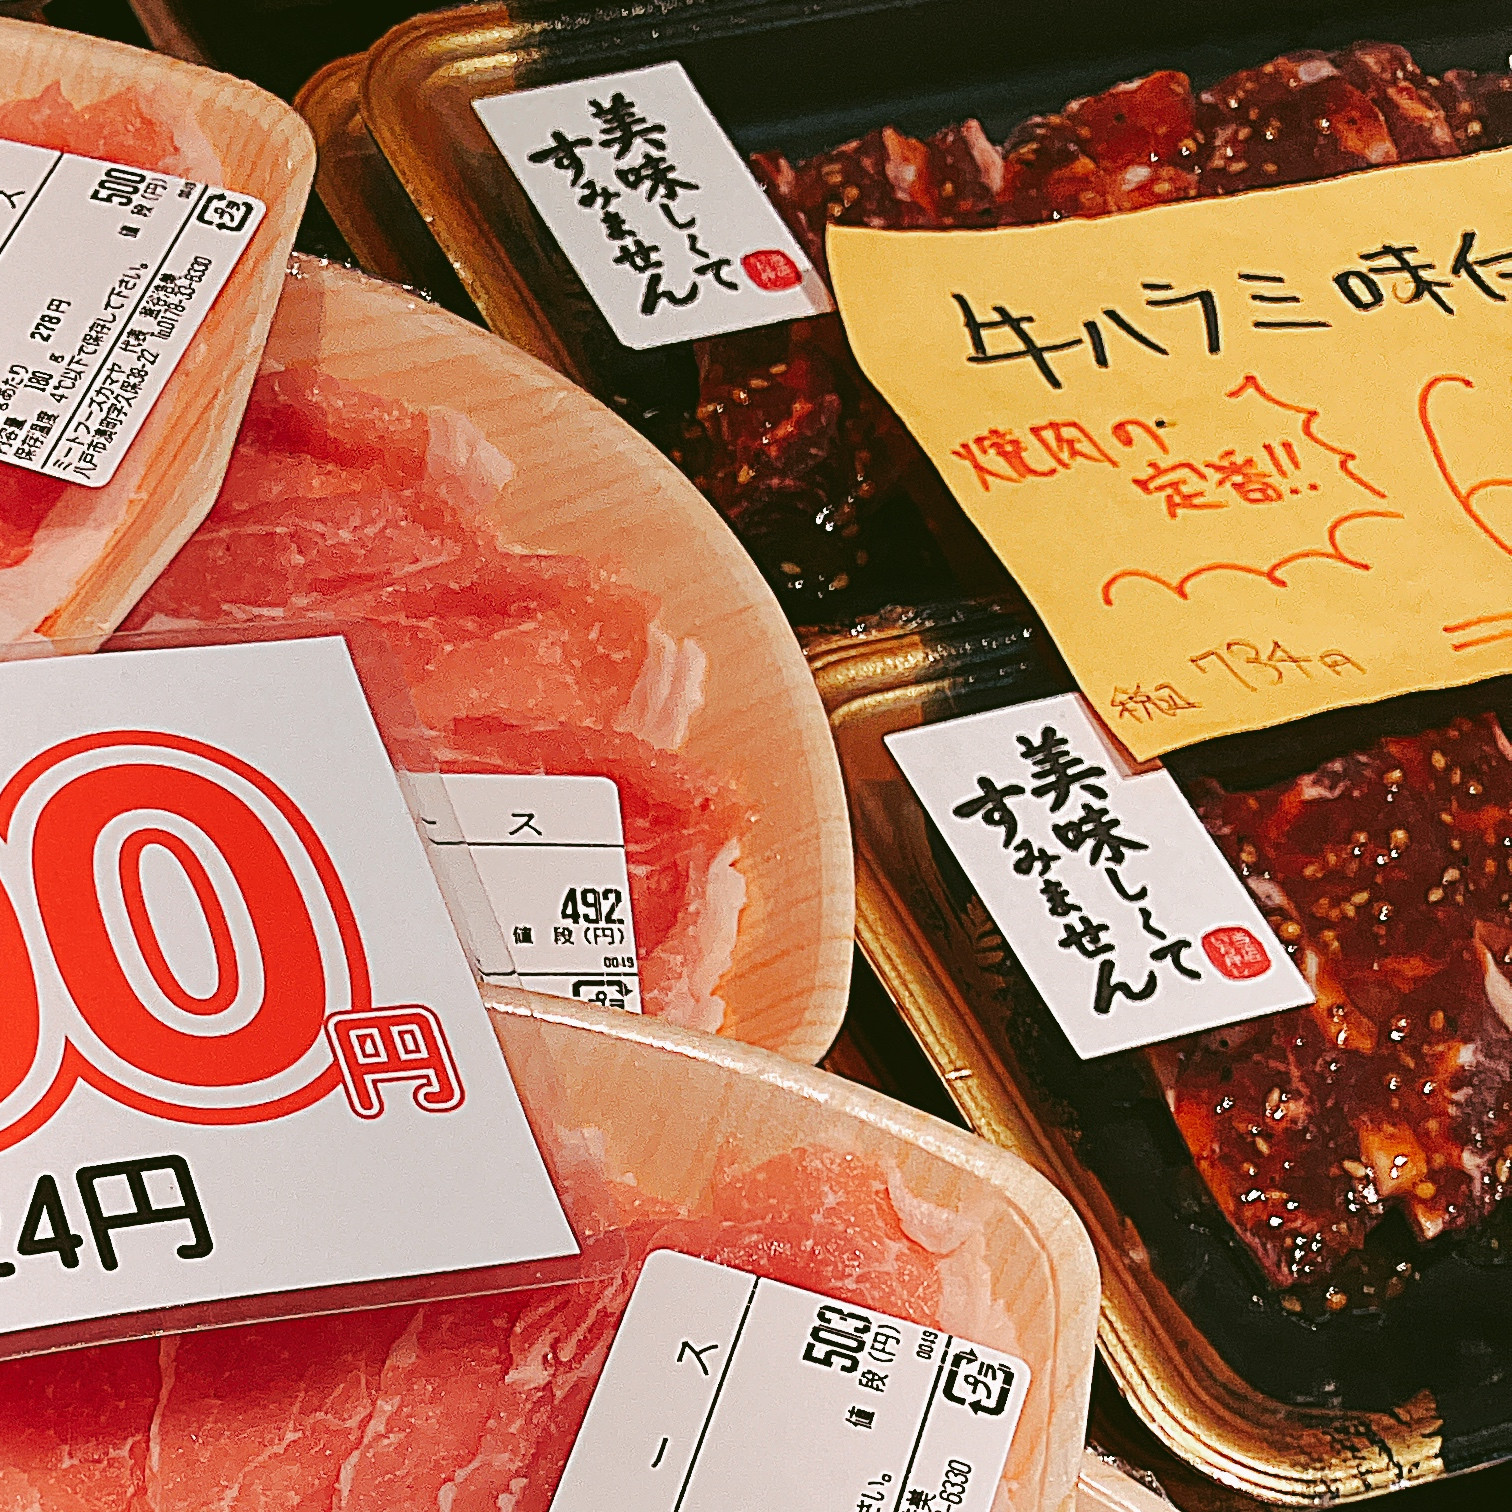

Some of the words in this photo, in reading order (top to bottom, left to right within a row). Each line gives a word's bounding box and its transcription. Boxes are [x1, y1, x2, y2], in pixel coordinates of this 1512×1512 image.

[90, 168, 147, 207] 500
[528, 130, 699, 315] すみません
[588, 92, 738, 291] 美味しくて
[951, 418, 1168, 492] 焼肉の
[561, 888, 624, 925] 492
[952, 777, 1157, 1014] すみません
[1016, 726, 1201, 980] 美味しくて
[803, 1305, 872, 1373] 503
